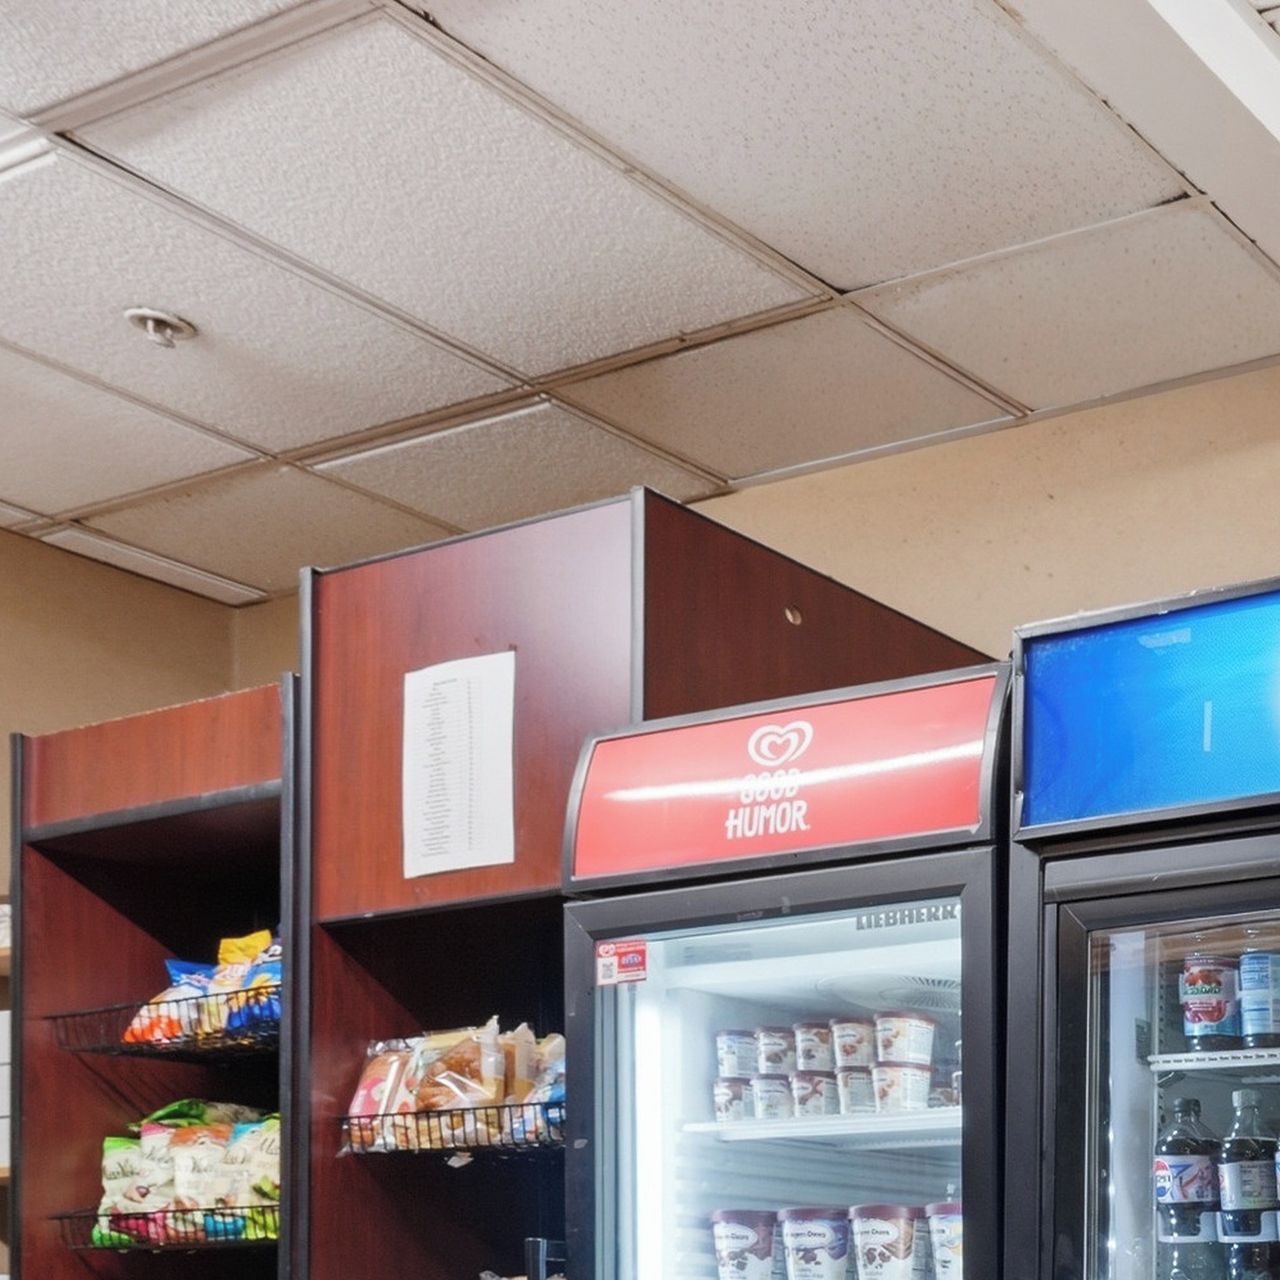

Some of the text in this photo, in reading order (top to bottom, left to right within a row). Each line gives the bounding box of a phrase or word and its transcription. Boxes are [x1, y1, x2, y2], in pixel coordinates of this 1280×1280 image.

[741, 768, 800, 804] GOOD
[725, 800, 806, 839] HUMOR
[856, 904, 958, 931] LIEBHERR
